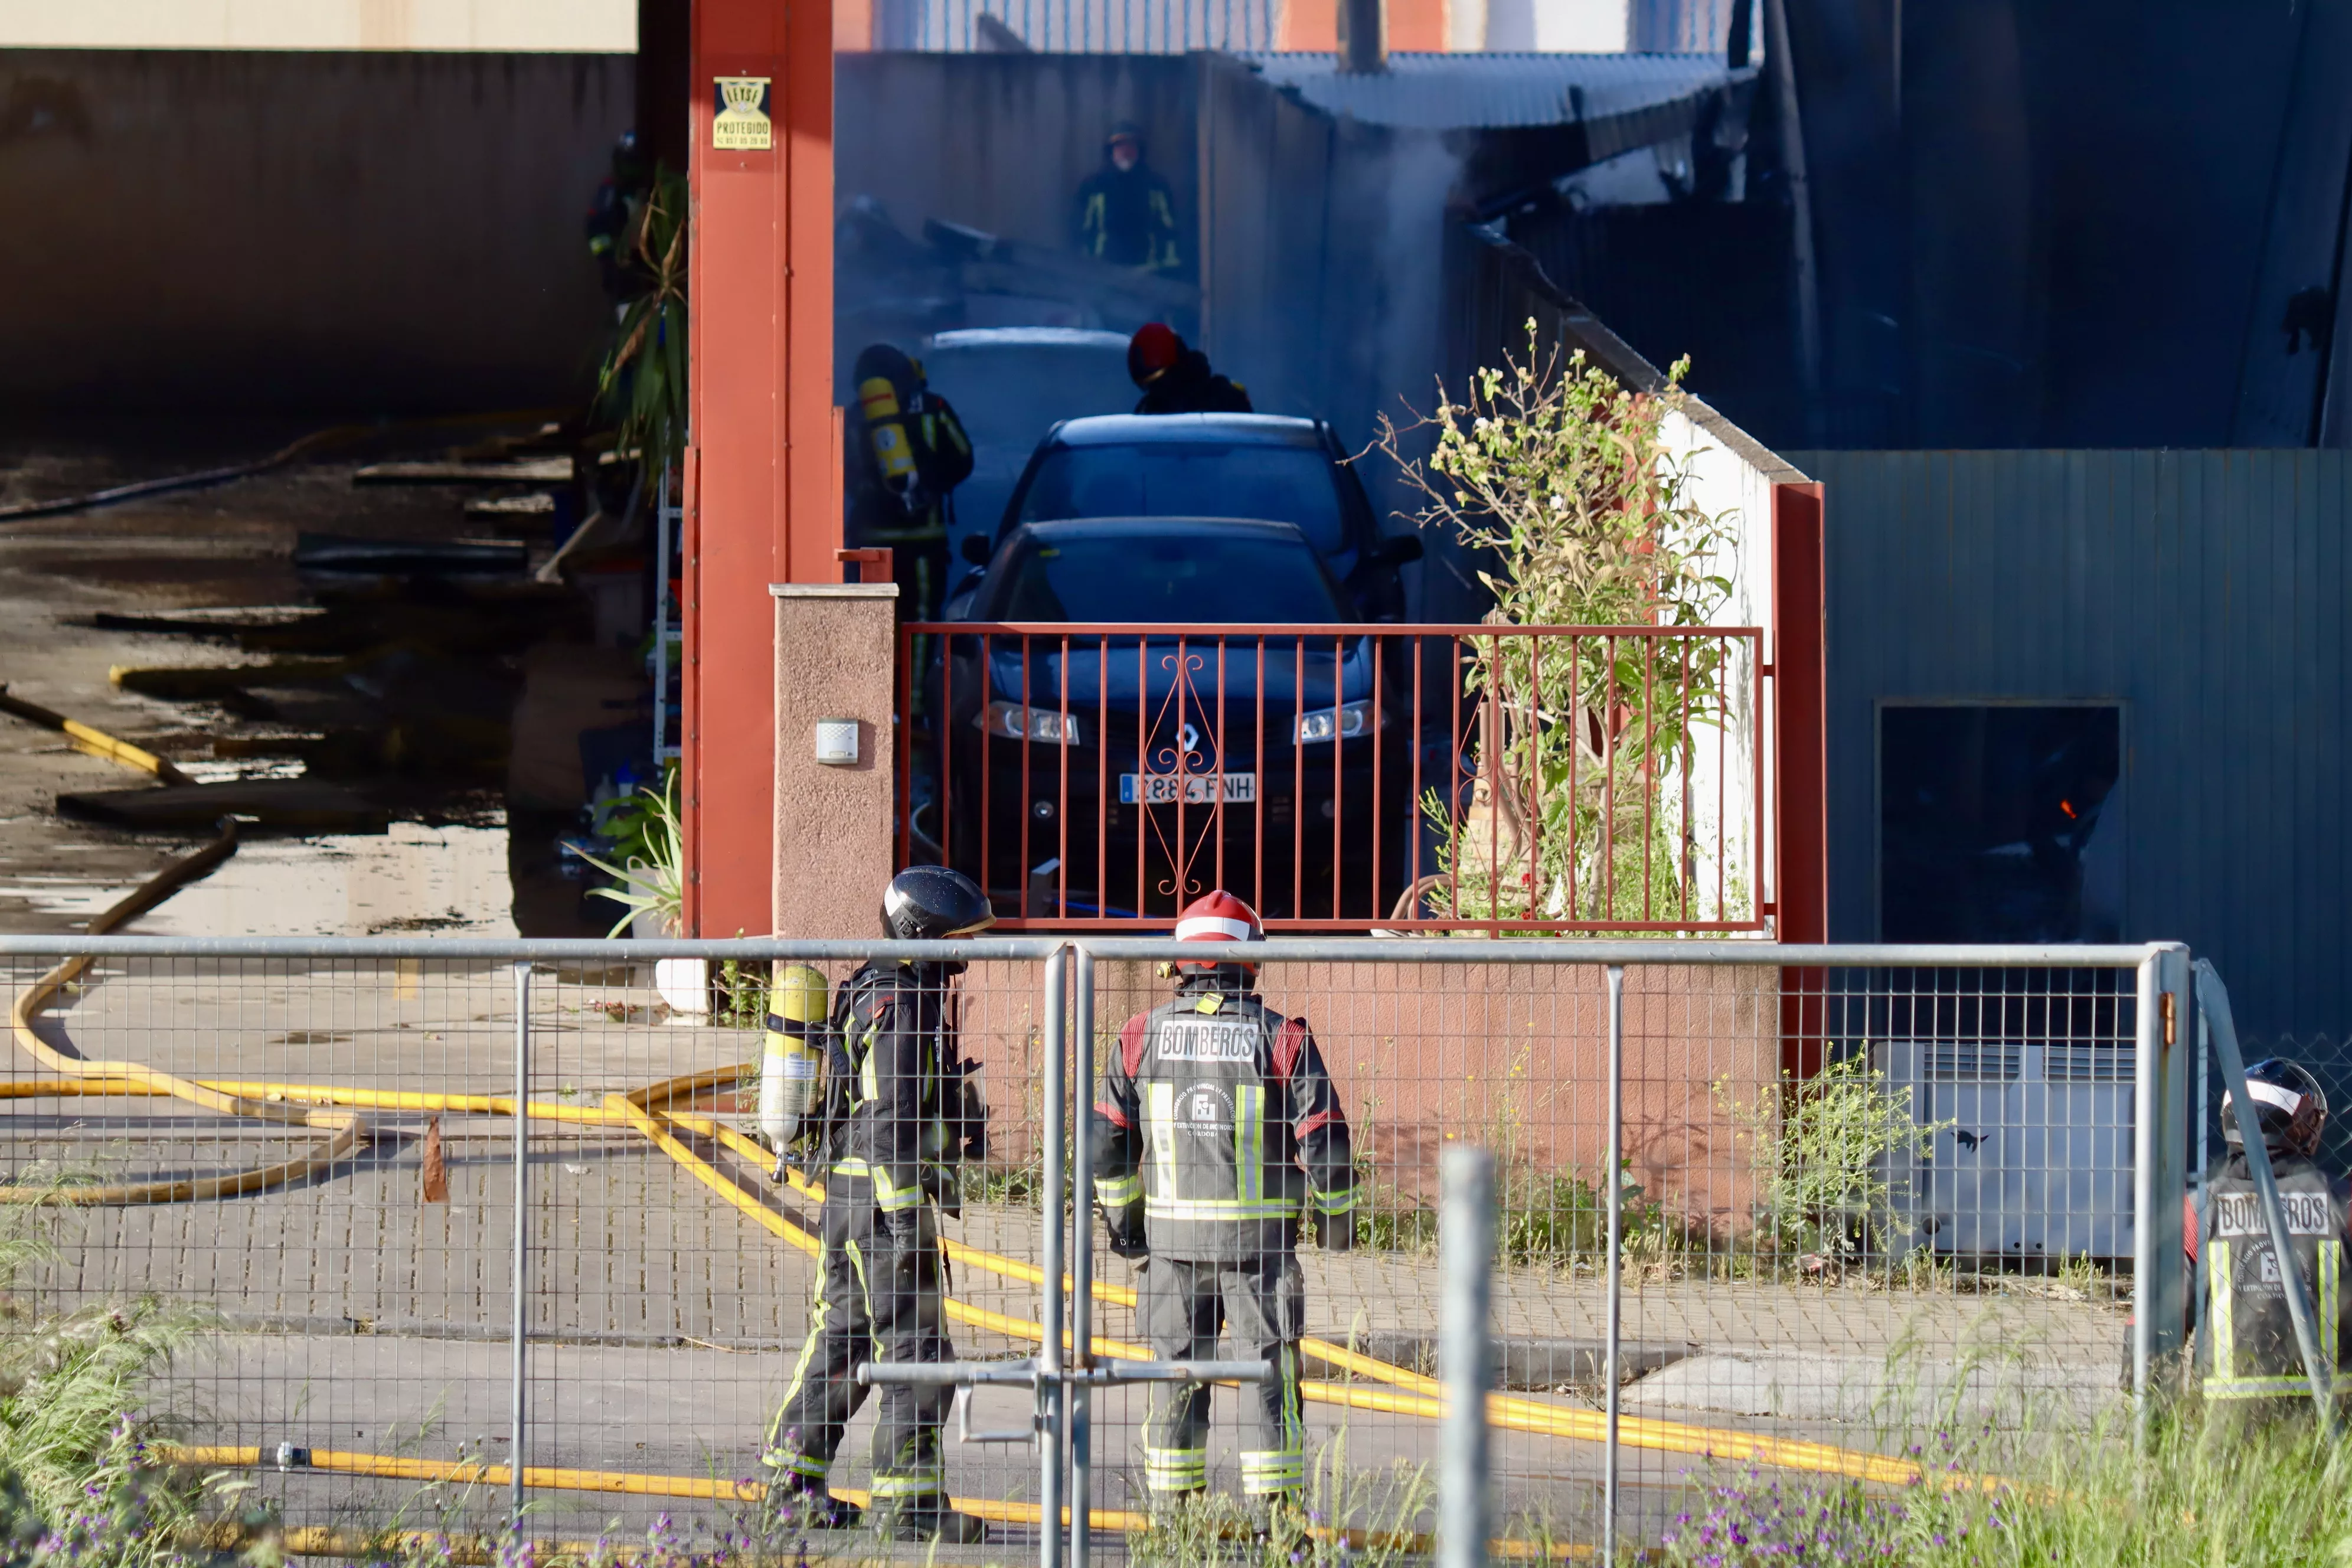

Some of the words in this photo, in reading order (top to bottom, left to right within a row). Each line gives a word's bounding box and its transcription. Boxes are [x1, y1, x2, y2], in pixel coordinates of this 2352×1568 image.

[717, 122, 768, 134] PROTEGIDO
[1162, 1025, 1254, 1057] BOMBEROS
[1174, 1092, 1187, 1120] CONSORCIO
[2221, 1197, 2325, 1230] BOMROS
